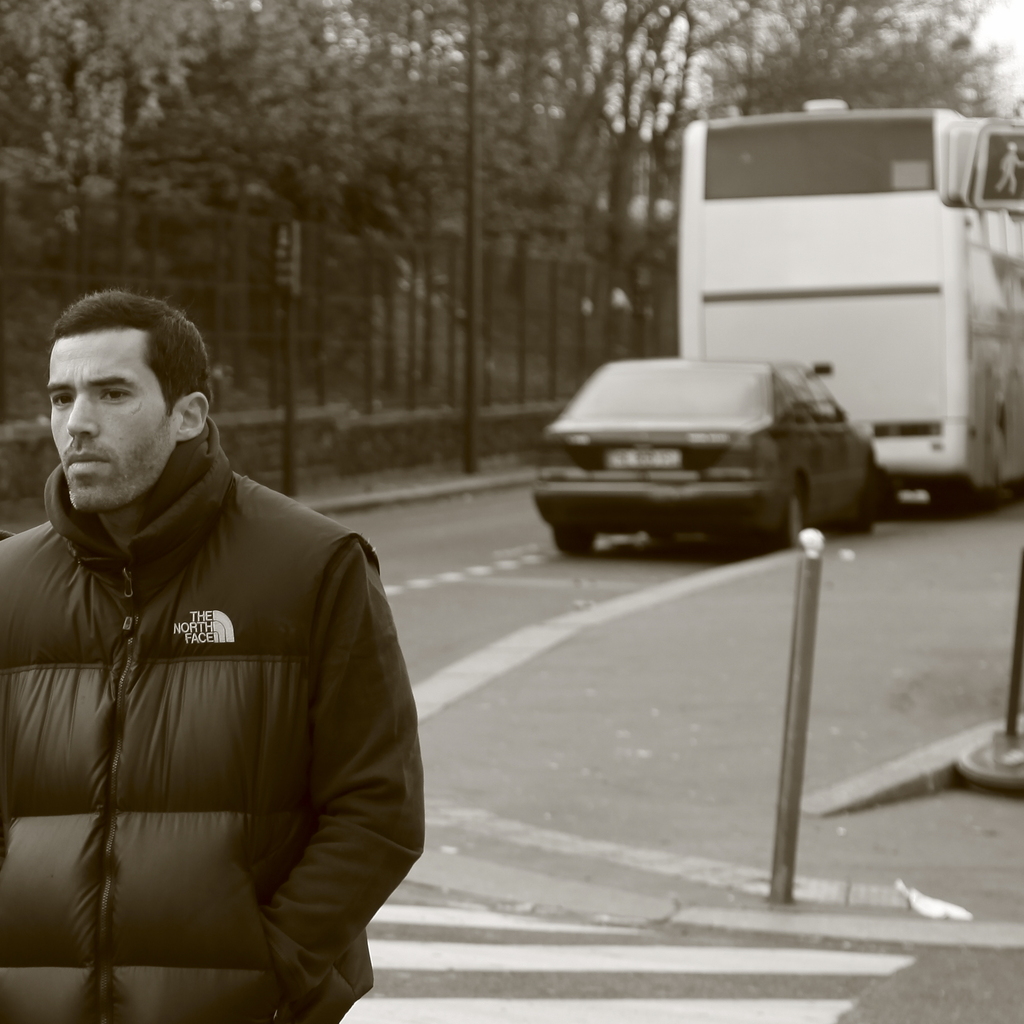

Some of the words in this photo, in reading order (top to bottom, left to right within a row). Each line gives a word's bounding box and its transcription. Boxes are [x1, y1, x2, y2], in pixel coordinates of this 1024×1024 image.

[189, 610, 213, 622] THE
[173, 621, 213, 634] NORTH
[184, 632, 214, 644] FACE
